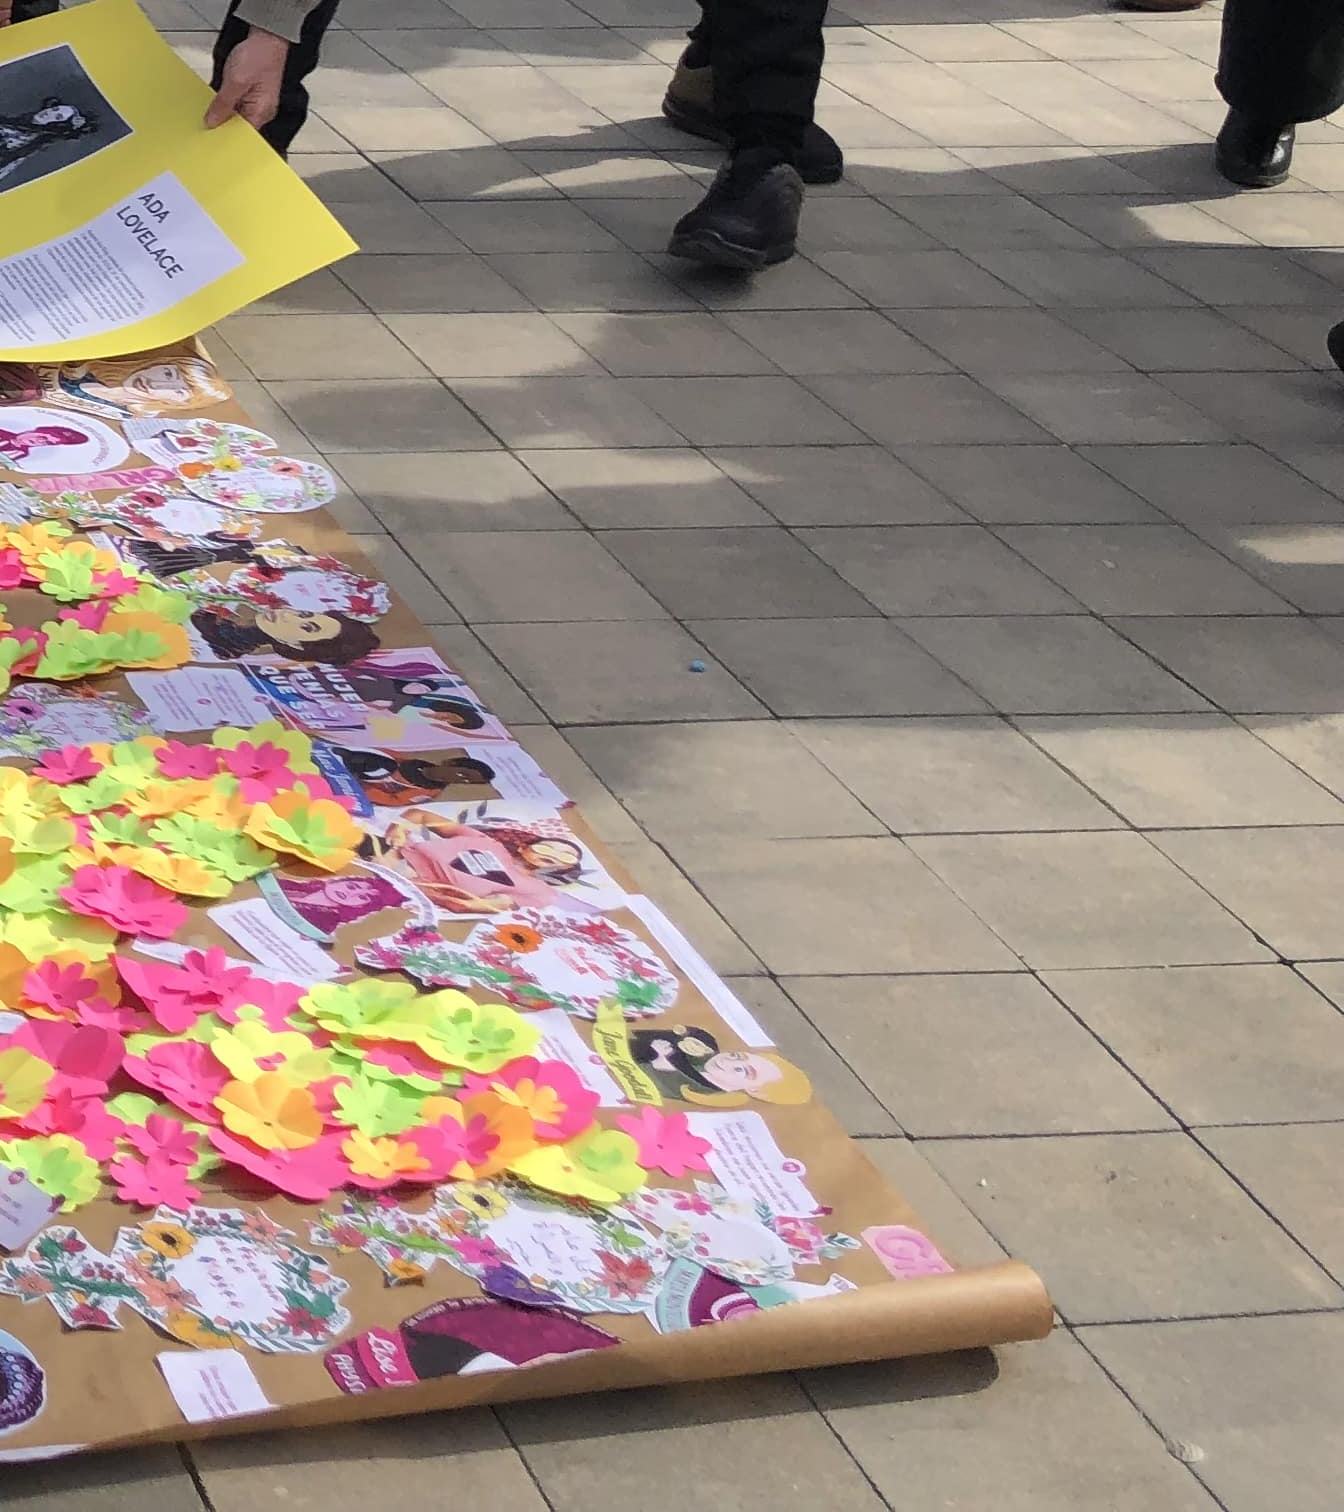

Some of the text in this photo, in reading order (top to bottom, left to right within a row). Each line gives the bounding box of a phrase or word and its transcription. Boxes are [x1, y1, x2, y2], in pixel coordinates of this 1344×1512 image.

[137, 192, 171, 223] ADA
[116, 205, 184, 280] LOVELACE
[259, 667, 295, 697] QUE
[318, 664, 369, 713] MUJER
[595, 1028, 624, 1058] Jane
